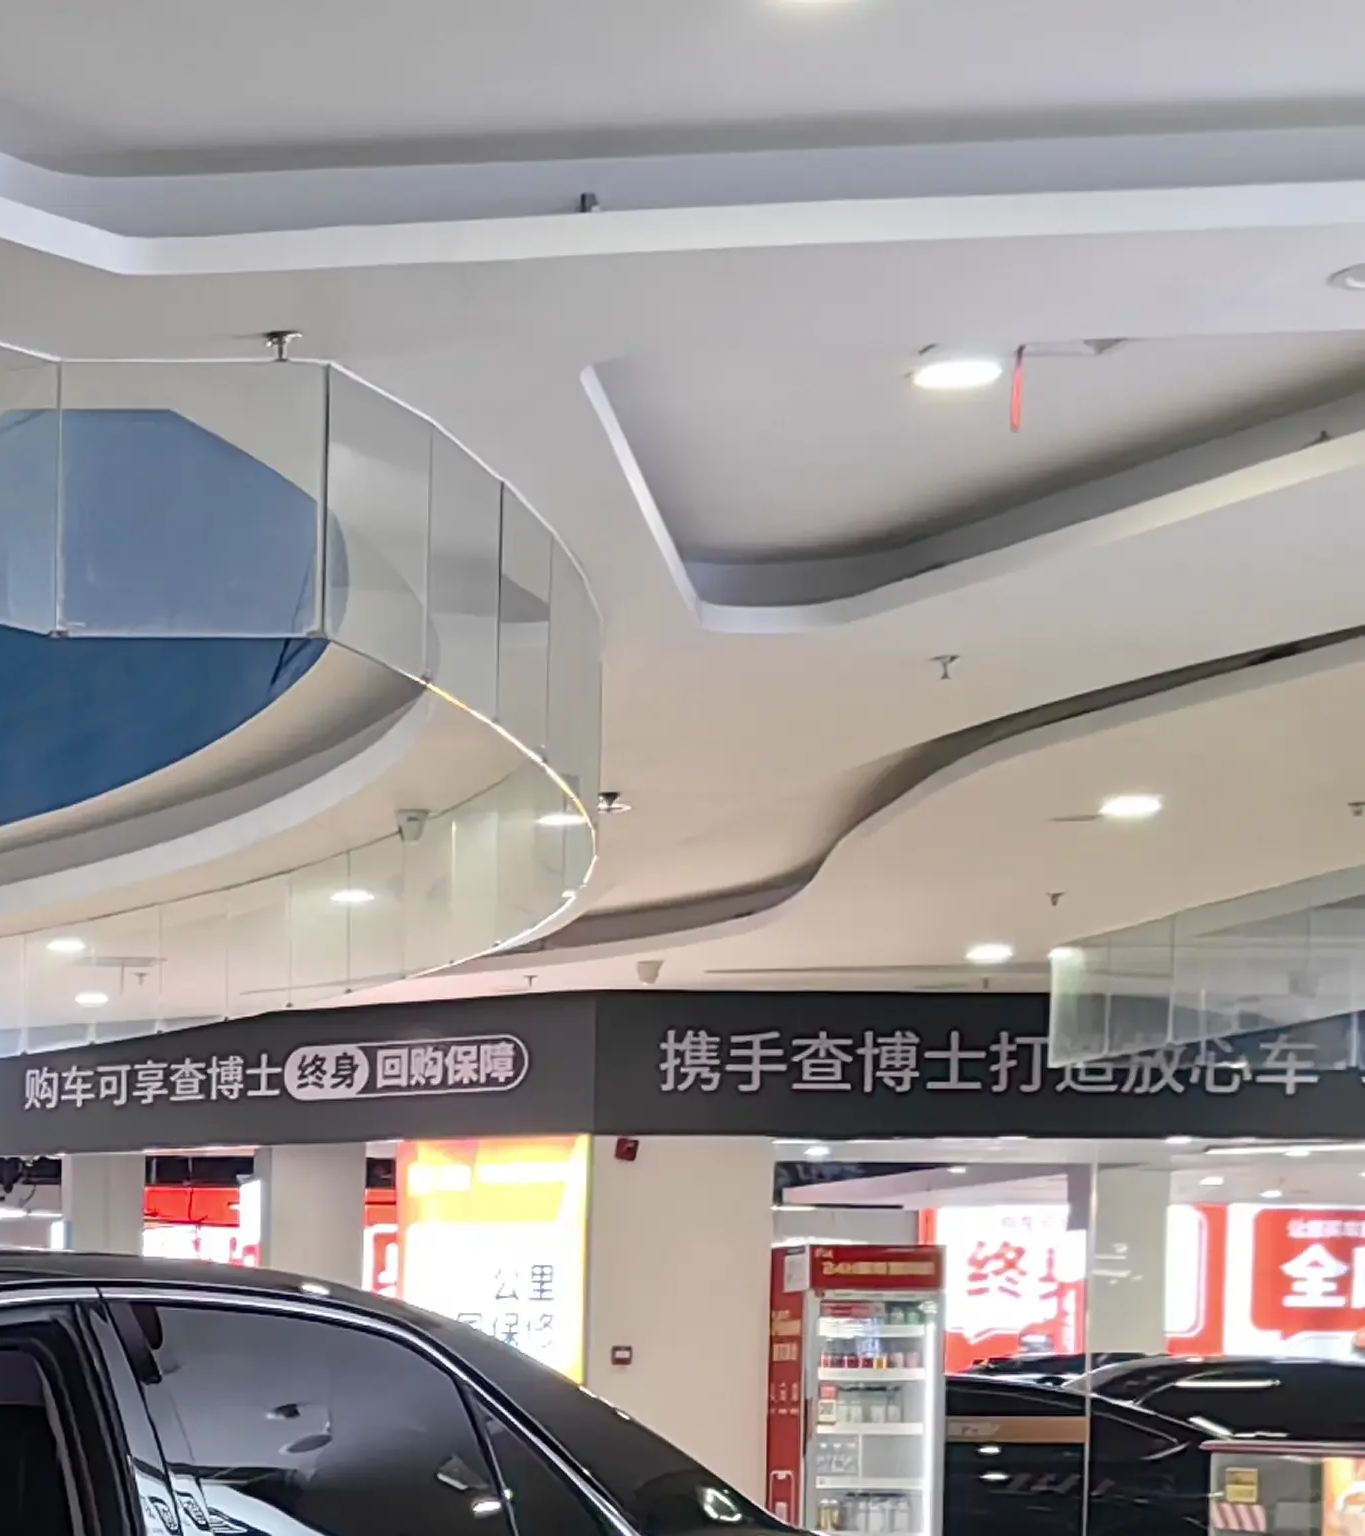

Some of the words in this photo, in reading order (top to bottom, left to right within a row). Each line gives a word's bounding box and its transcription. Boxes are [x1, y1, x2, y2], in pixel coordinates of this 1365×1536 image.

[24, 1054, 283, 1111] 购车可享查博士
[296, 1050, 361, 1091] 终身
[375, 1042, 517, 1088] 回购保障
[659, 1029, 1320, 1095] 携手查博士打造放心车
[495, 1265, 555, 1300] 公里
[1279, 1243, 1365, 1308] 全
